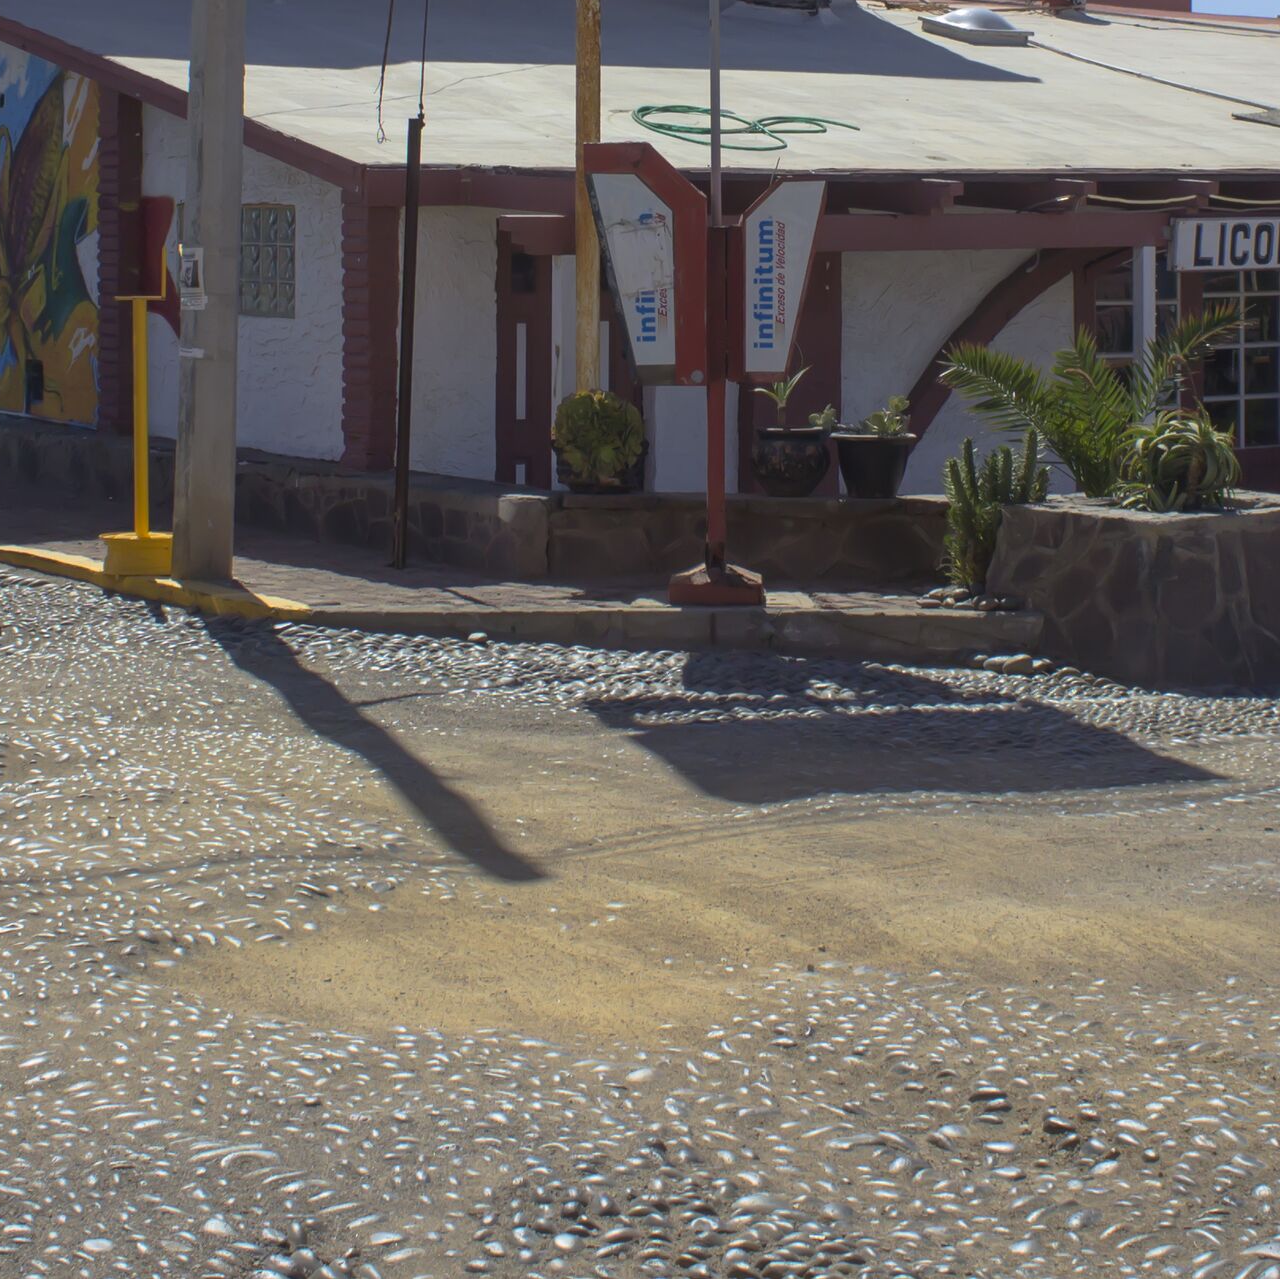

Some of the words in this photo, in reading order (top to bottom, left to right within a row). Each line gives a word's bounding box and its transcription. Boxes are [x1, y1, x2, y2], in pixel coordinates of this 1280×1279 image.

[775, 221, 786, 270] Velocidad
[753, 220, 774, 350] infinitum
[775, 273, 786, 286] de
[775, 288, 786, 325] Exceso
